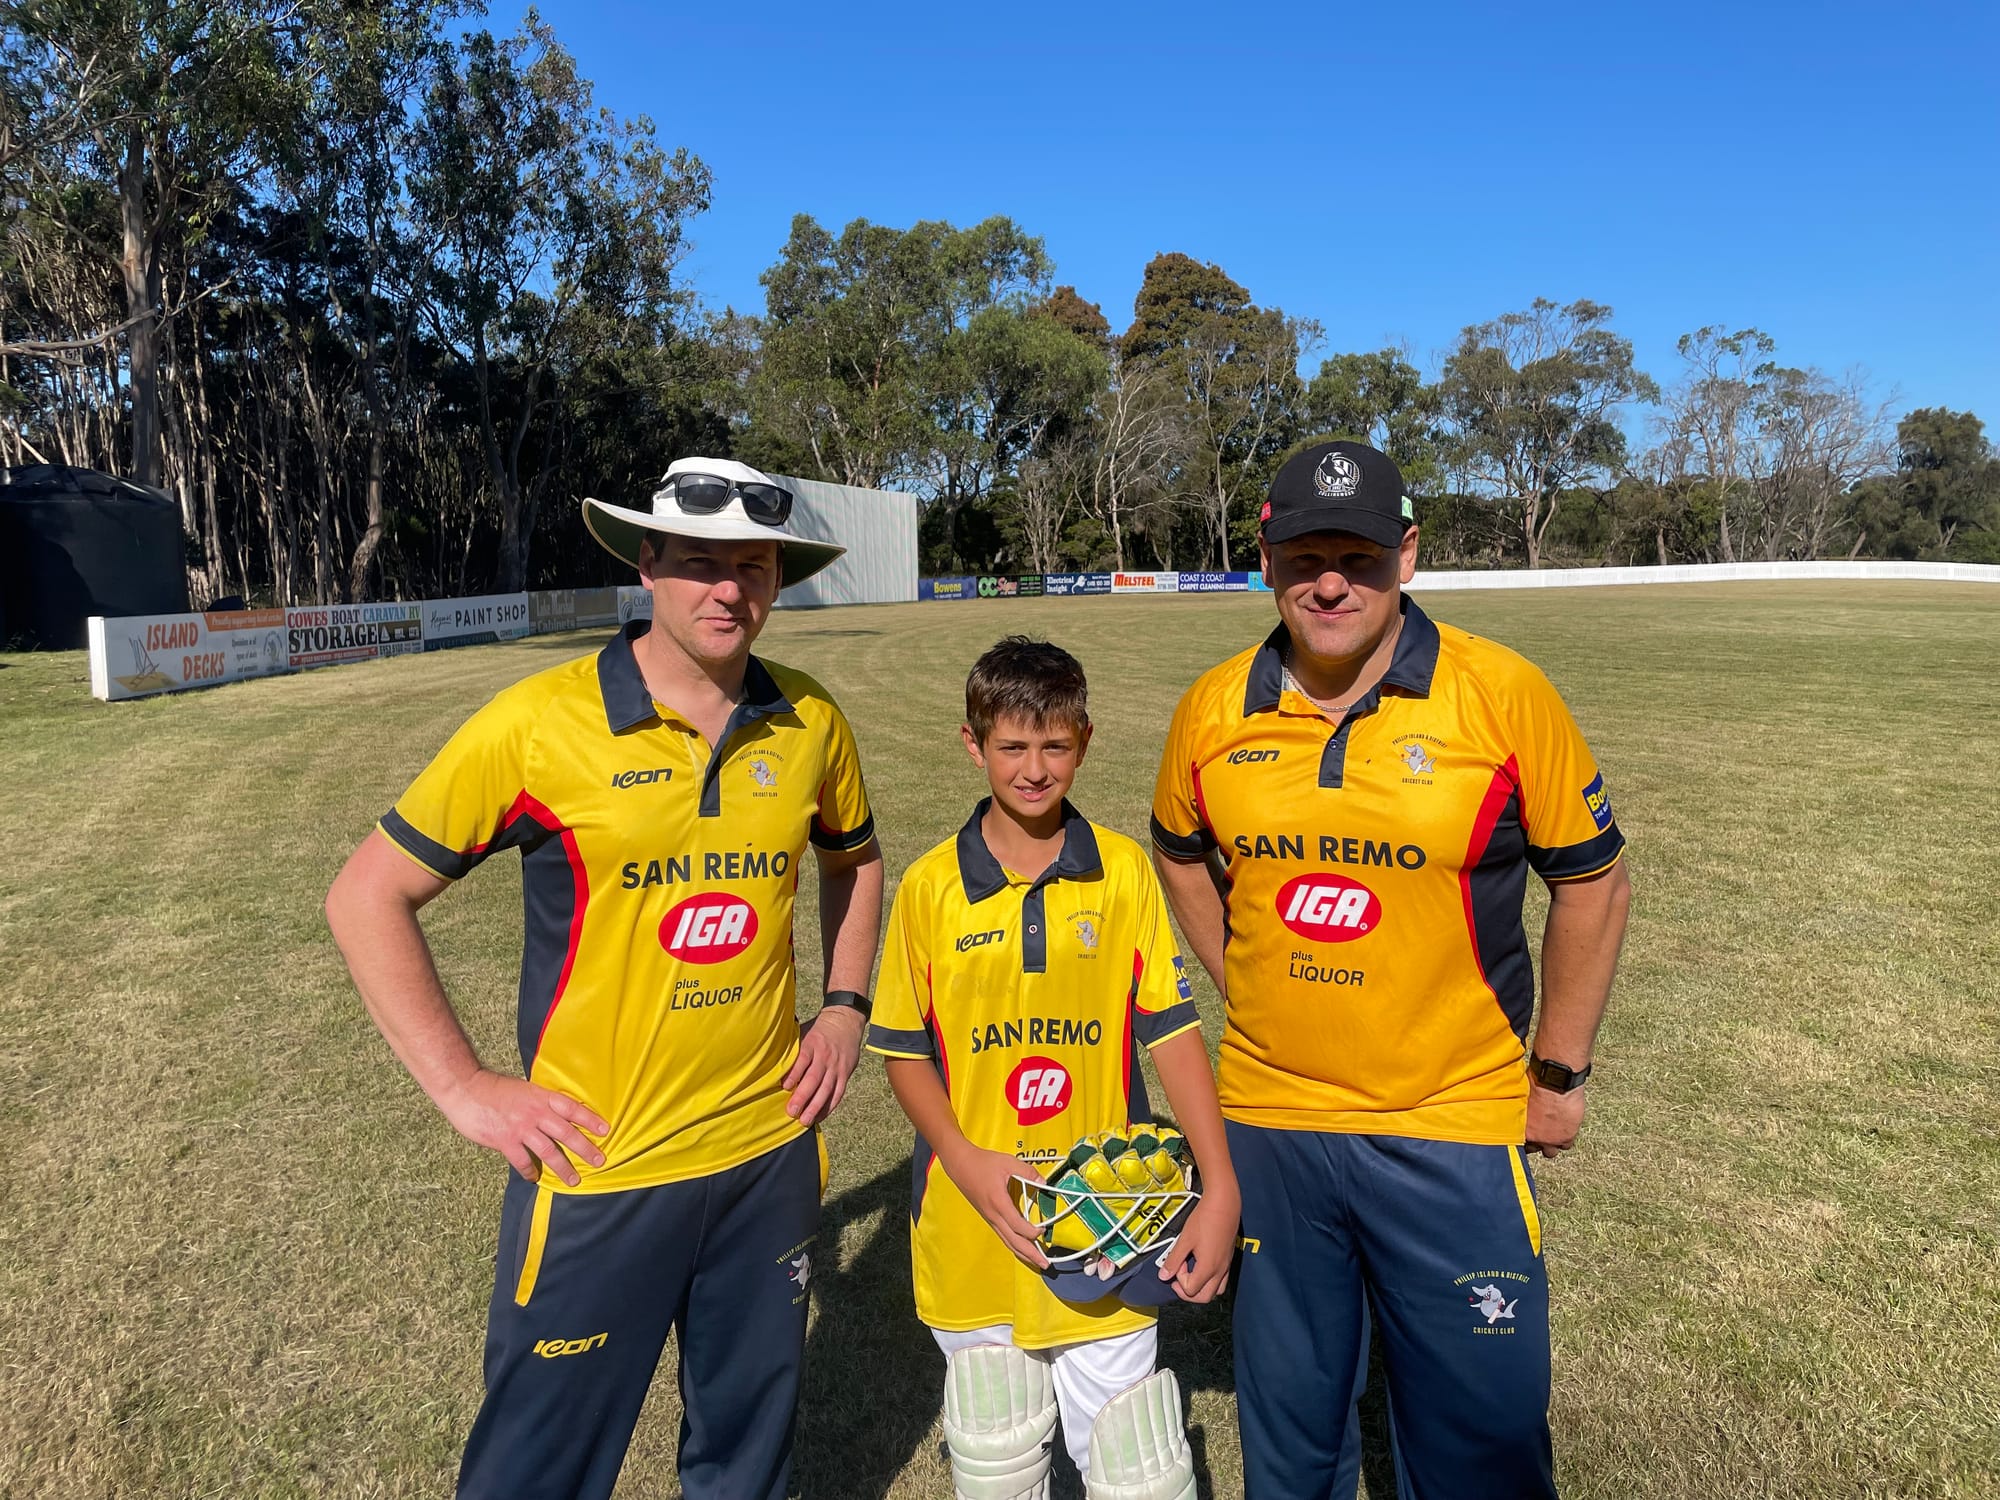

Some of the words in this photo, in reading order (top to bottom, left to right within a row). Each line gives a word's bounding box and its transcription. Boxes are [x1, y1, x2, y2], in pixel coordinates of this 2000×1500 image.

[934, 582, 962, 593] Bowens
[1114, 574, 1155, 586] MELSTEEL
[1180, 574, 1200, 582] COAST
[1201, 574, 1206, 582] 2
[1206, 574, 1225, 582] COAST
[288, 611, 328, 629] COWES
[332, 609, 360, 625] BOAT
[363, 606, 406, 622] CARAVAN
[409, 605, 420, 620] RV
[455, 607, 492, 628] PAINT
[497, 604, 526, 623] SHOP
[146, 622, 198, 651] ISLAND
[289, 624, 378, 653] STORAGE
[183, 652, 225, 681] DECKS
[1234, 834, 1305, 860] SAN
[1319, 835, 1427, 871] REMO
[621, 855, 691, 890] SAN
[704, 850, 789, 881] REMO
[1285, 884, 1370, 928] IGA
[670, 904, 749, 950] IGA
[1291, 951, 1313, 962] plus
[674, 978, 700, 992] plus
[1289, 963, 1365, 986] LIQUOR
[670, 986, 743, 1011] LIQUOR
[972, 1018, 1023, 1054] SAN
[1029, 1018, 1102, 1046] REMO
[1018, 1069, 1066, 1109] GA
[1454, 1272, 1476, 1286] PHILLIP
[1477, 1270, 1499, 1278] ISLAND
[1506, 1272, 1530, 1284] DISTRICT
[1500, 1327, 1515, 1335] CLUB
